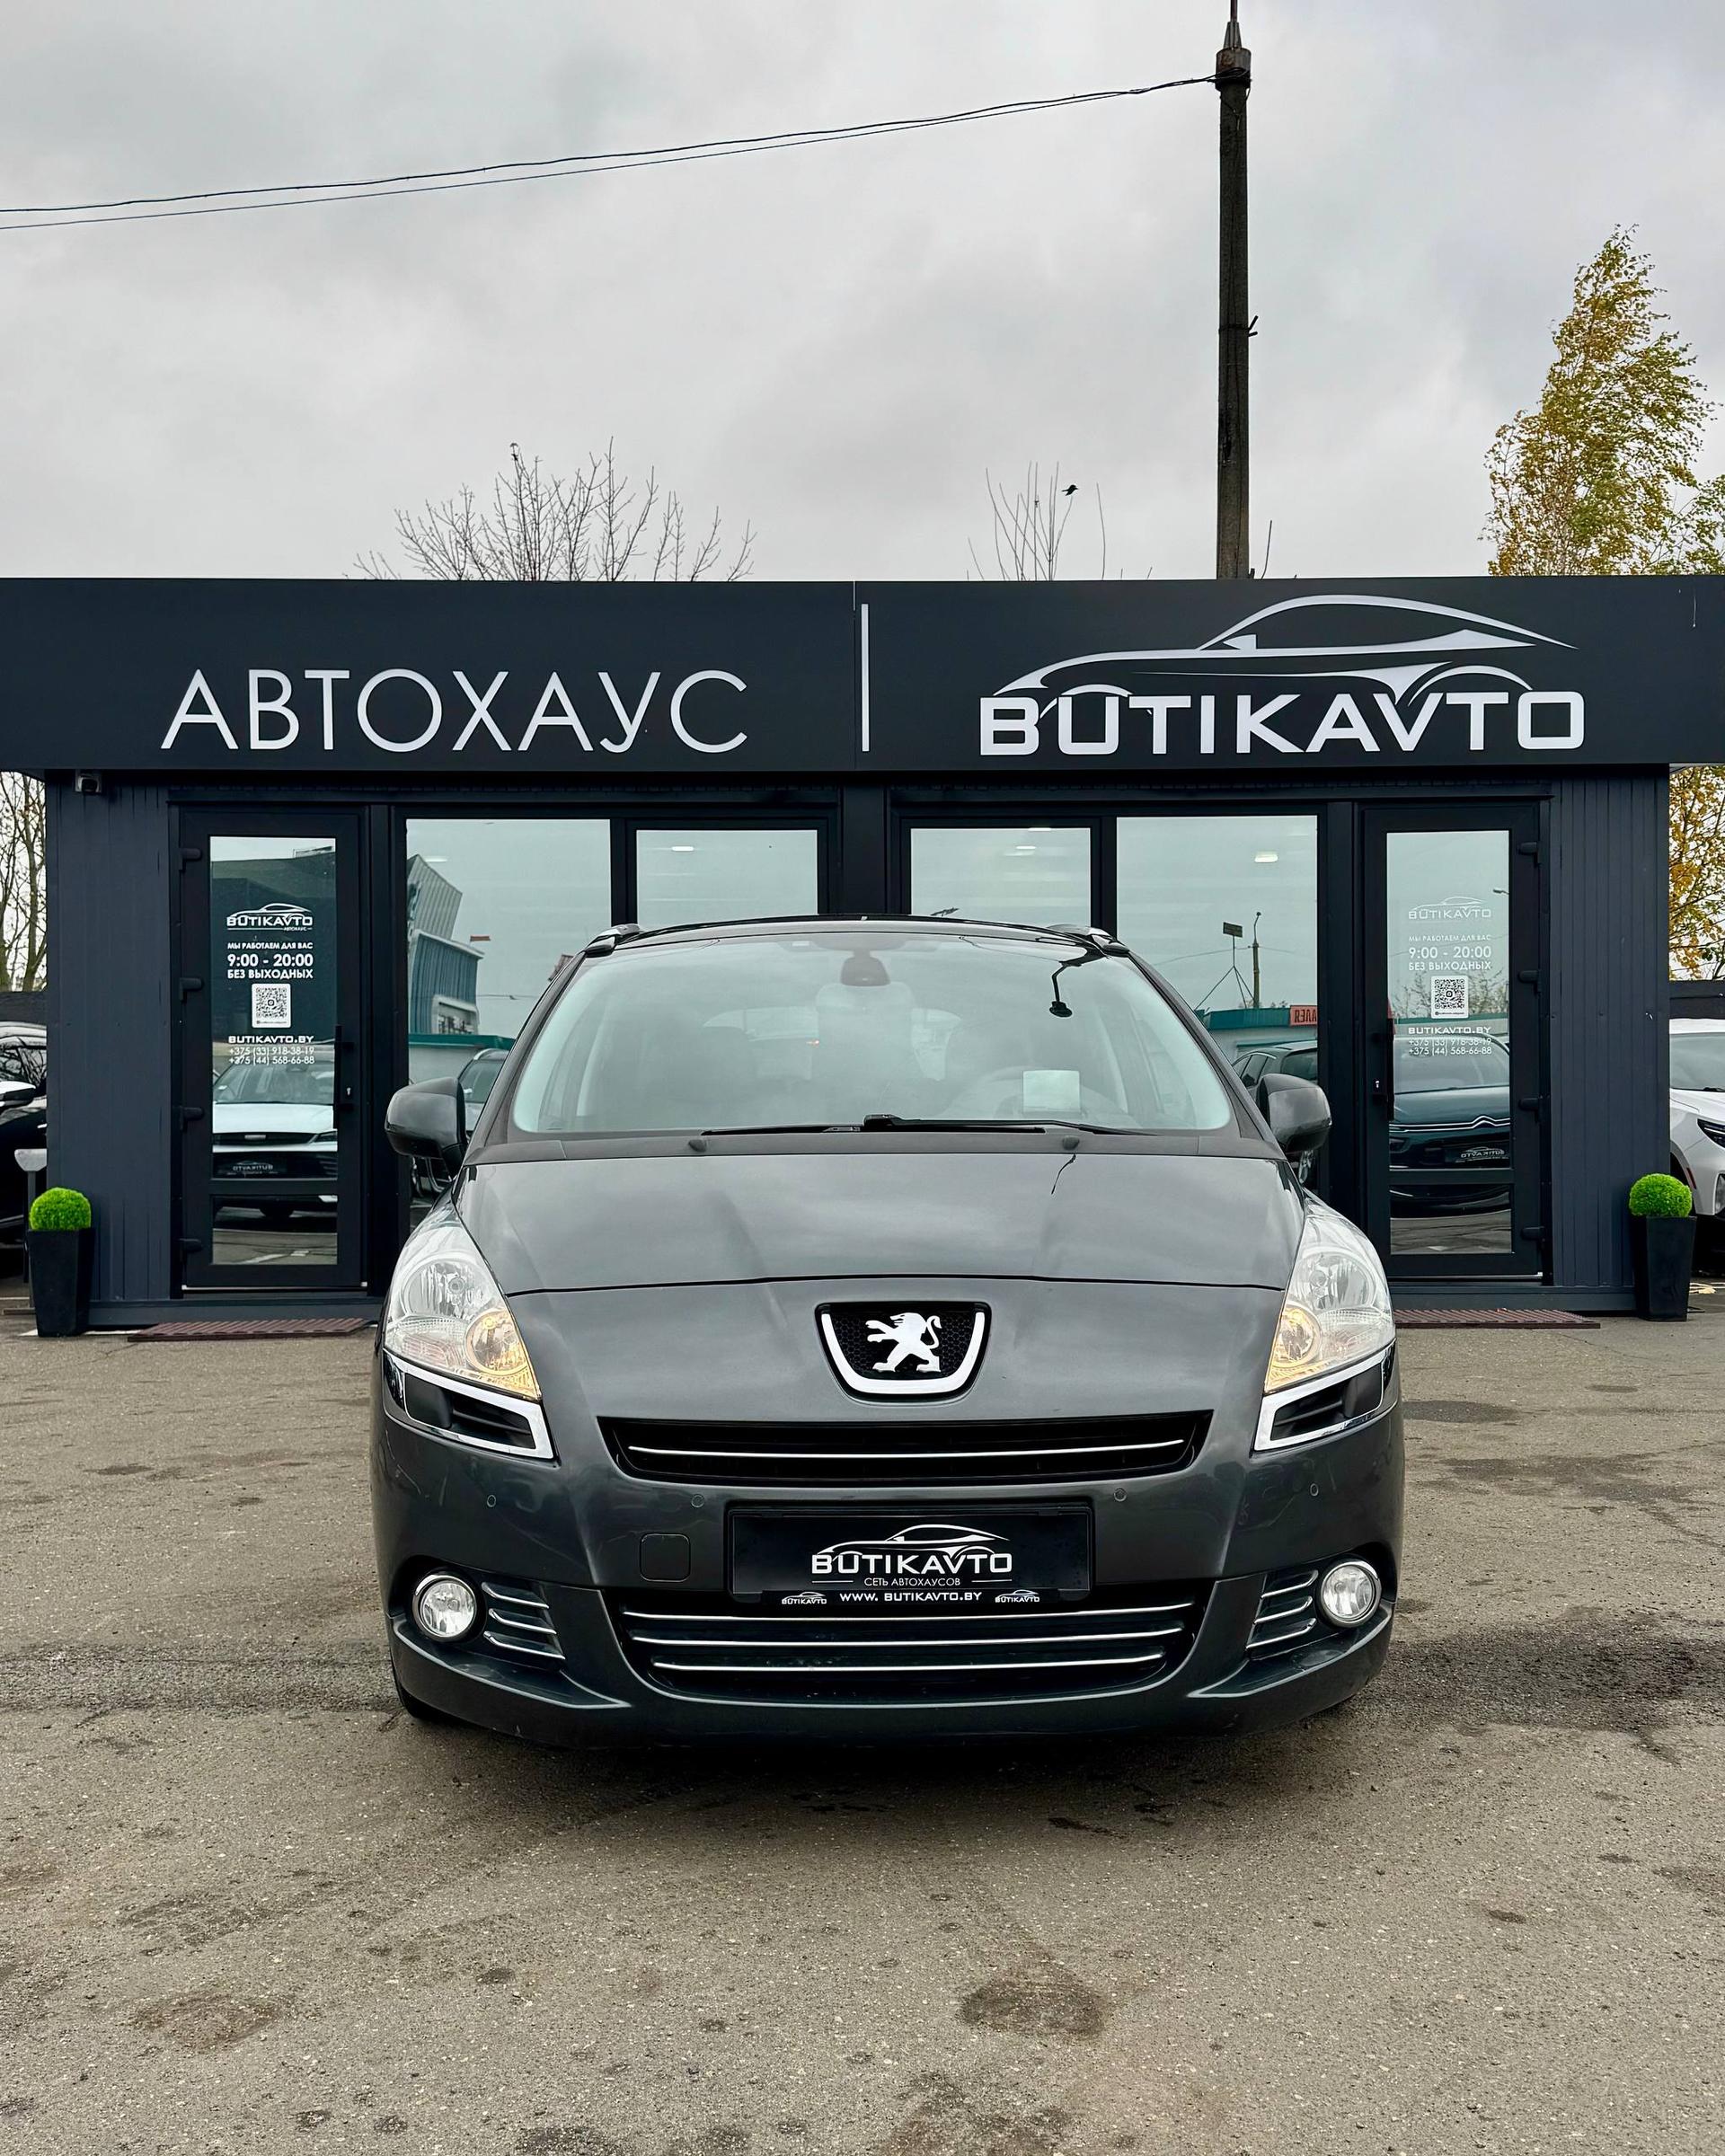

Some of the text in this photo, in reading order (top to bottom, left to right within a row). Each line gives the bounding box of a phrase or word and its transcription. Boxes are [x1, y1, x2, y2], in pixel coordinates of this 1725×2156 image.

[161, 667, 749, 754] АВТОХАУС
[980, 690, 1586, 756] BUTIKAVTO
[1408, 909, 1491, 919] BUTIKAVTO
[226, 916, 313, 926] BUTIKAVTO
[1409, 947, 1438, 959] 9:00
[1454, 946, 1491, 958] 20:00
[227, 954, 258, 967] 9:00
[273, 954, 314, 967] 20:00
[1408, 961, 1491, 971] БЕЗ ВЫХОДНЫХ
[227, 968, 314, 980] БЕЗ ВЫХОДНЫХ
[1450, 1038, 1491, 1046] 918-38-19
[253, 1047, 270, 1056] (33)
[1432, 1047, 1447, 1056] (44)
[229, 1056, 251, 1065] +375
[253, 1056, 270, 1065] (44)
[811, 1553, 1013, 1574] BUTIKAVTO
[864, 1578, 960, 1586] СЕТЬ АВТОХАУСОВ
[884, 1592, 982, 1601] BUTIKAVTO.BY
